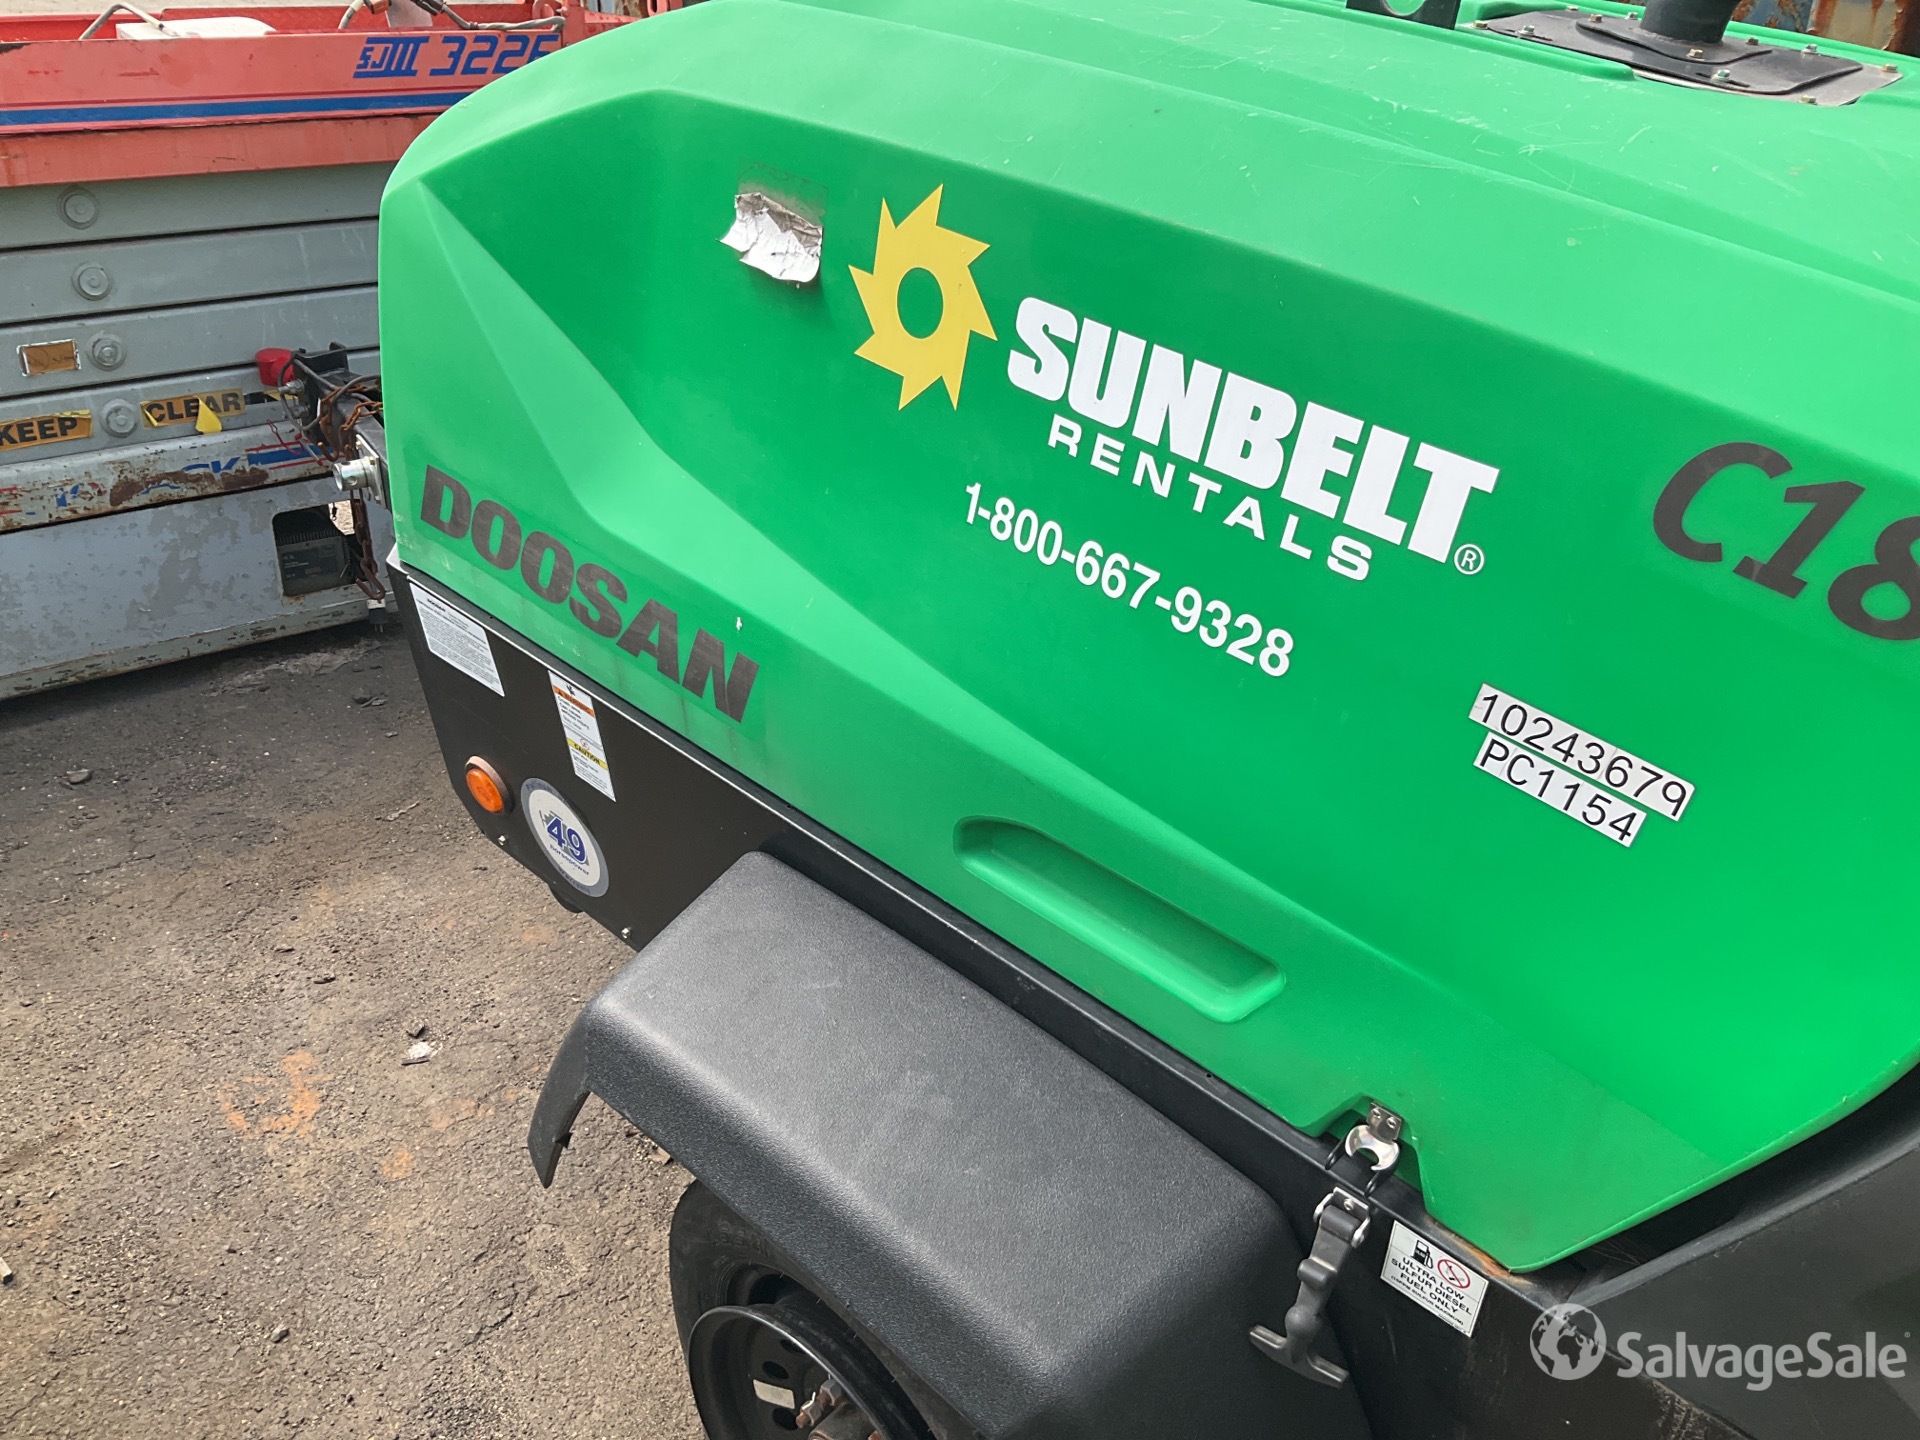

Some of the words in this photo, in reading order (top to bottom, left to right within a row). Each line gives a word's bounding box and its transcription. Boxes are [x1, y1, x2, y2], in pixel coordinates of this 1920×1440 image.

[0, 416, 78, 446] KEEP
[145, 391, 242, 424] CLEAR
[1008, 297, 1500, 563] SUNBELT
[1047, 413, 1373, 581] RENTALS
[420, 464, 760, 724] DOOSAN
[965, 482, 1294, 677] 1-800-667-9328
[573, 742, 601, 766] CAUTION
[1479, 738, 1637, 841] PC1154
[1481, 694, 1688, 817] 10243679
[547, 816, 586, 863] 49
[1391, 1258, 1432, 1289] SULFUR
[1435, 1286, 1472, 1315] DIESEL
[1400, 1272, 1427, 1294] FUEL
[1429, 1292, 1458, 1314] ONLY
[1402, 1256, 1437, 1284] ULTRA
[1439, 1281, 1465, 1301] LOW
